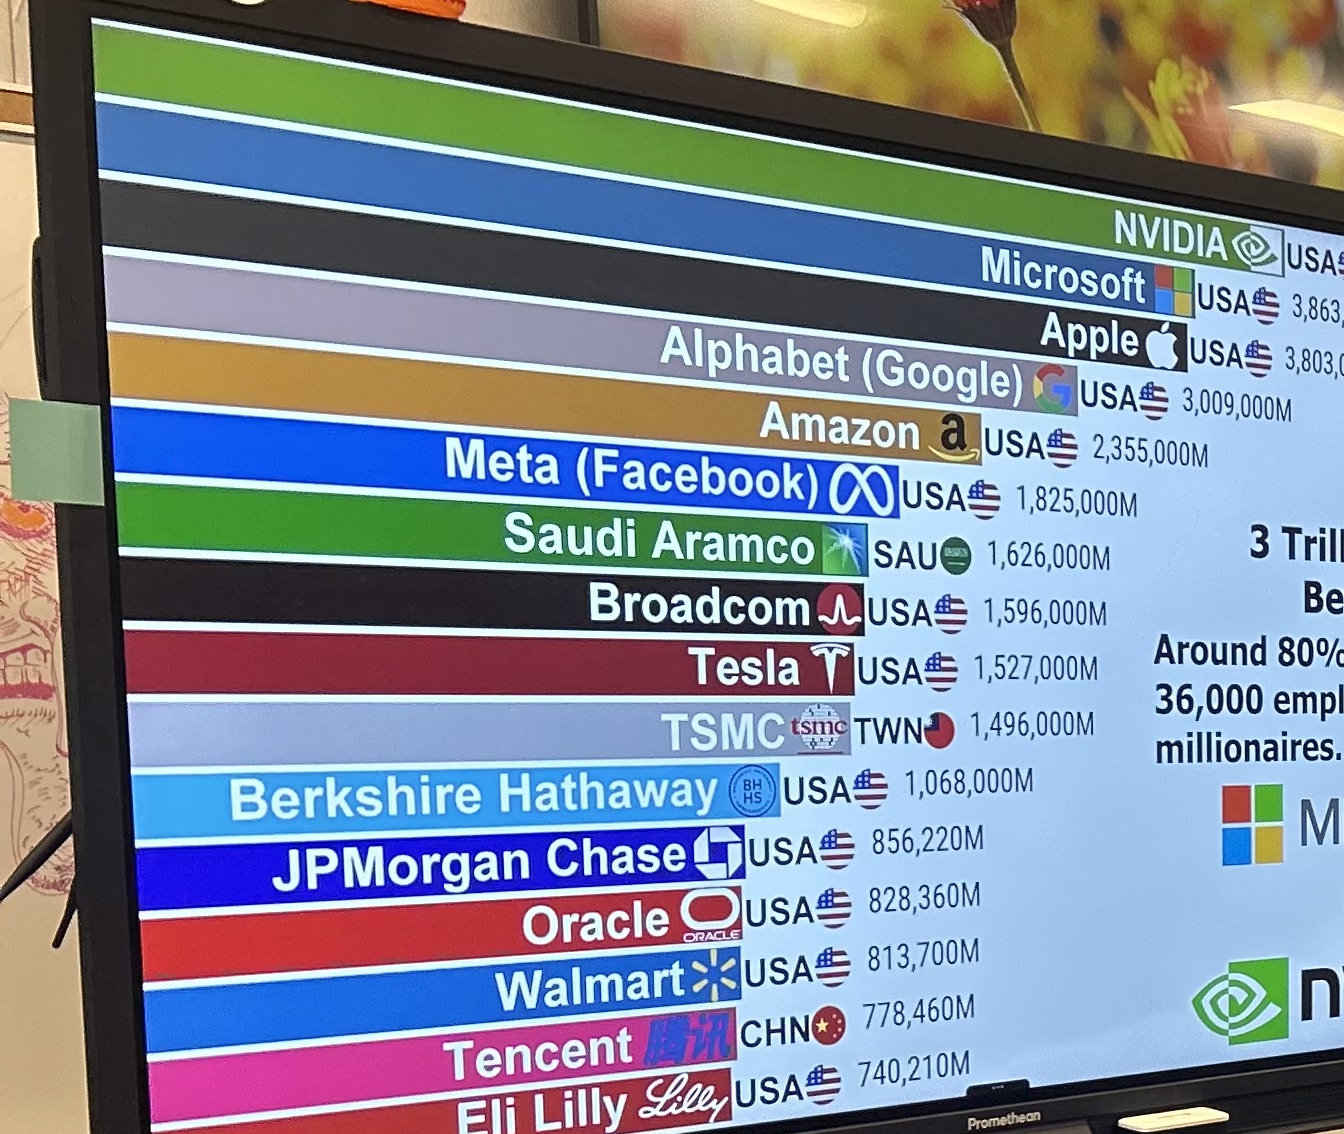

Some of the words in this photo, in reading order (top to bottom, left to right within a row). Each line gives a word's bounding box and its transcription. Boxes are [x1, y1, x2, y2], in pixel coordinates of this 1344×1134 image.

[1114, 209, 1228, 261] NVIDIA
[1287, 243, 1337, 275] USA
[981, 245, 1147, 304] Microsoft
[1198, 284, 1250, 317] USA
[1040, 312, 1140, 361] Apple
[1190, 337, 1243, 369] USA
[661, 325, 850, 383] Alphabet
[862, 347, 1023, 408] (Google)
[1081, 380, 1138, 414] USA
[1182, 387, 1292, 423] 3,009,000M
[760, 401, 920, 450] Amazon
[985, 429, 1045, 462] USA
[1092, 434, 1209, 468] 2,355,000M
[446, 436, 560, 486] Meta
[577, 447, 818, 509] (Facebook)
[902, 480, 967, 512] USA
[1016, 484, 1138, 518] 1,825,000M
[505, 512, 636, 557] Saudi
[652, 519, 815, 566] Aramco
[874, 540, 937, 570] SAU
[987, 540, 1111, 571] 1,626,000M
[1249, 524, 1270, 559] 3
[589, 582, 810, 626] Broadcom
[868, 599, 932, 628] USA
[984, 598, 1107, 627] 1,596,000M
[688, 647, 800, 686] Tesla
[858, 658, 922, 686] USA
[974, 654, 1098, 683] 1,527,000M
[1154, 633, 1268, 666] Around
[790, 717, 848, 737] tsmc
[1155, 684, 1264, 721] 36,000
[661, 712, 786, 751] TSMC
[854, 717, 922, 744] TWN
[970, 711, 1095, 742] 1,496,000M
[1156, 731, 1342, 764] millionaires.
[230, 775, 482, 822] Berkshire
[500, 766, 717, 816] Hathaway
[784, 776, 851, 805] USA
[905, 767, 1034, 799] 1,068,000M
[743, 778, 763, 792] BH
[744, 791, 763, 805] HS
[272, 846, 530, 893] JPMorgan
[547, 836, 686, 878] Chase
[749, 836, 817, 867] USA
[872, 825, 985, 856] 856,220M
[523, 900, 669, 945] Oracle
[746, 896, 814, 927] USA
[869, 882, 981, 914] 828,360M
[683, 929, 742, 943] ORACLE
[495, 960, 686, 1011] Walmart
[745, 955, 813, 988] USA
[868, 938, 980, 972] 813,700M
[443, 1026, 633, 1082] Tencent
[741, 1015, 811, 1049] CHN
[862, 994, 976, 1030] 778,460M
[643, 1012, 732, 1066] 腾讯
[535, 1086, 628, 1133] Lilly
[736, 1075, 804, 1108] USA
[858, 1050, 971, 1088] 740,210M
[638, 1072, 732, 1124] Lilly
[967, 1109, 1042, 1132] Promethean
